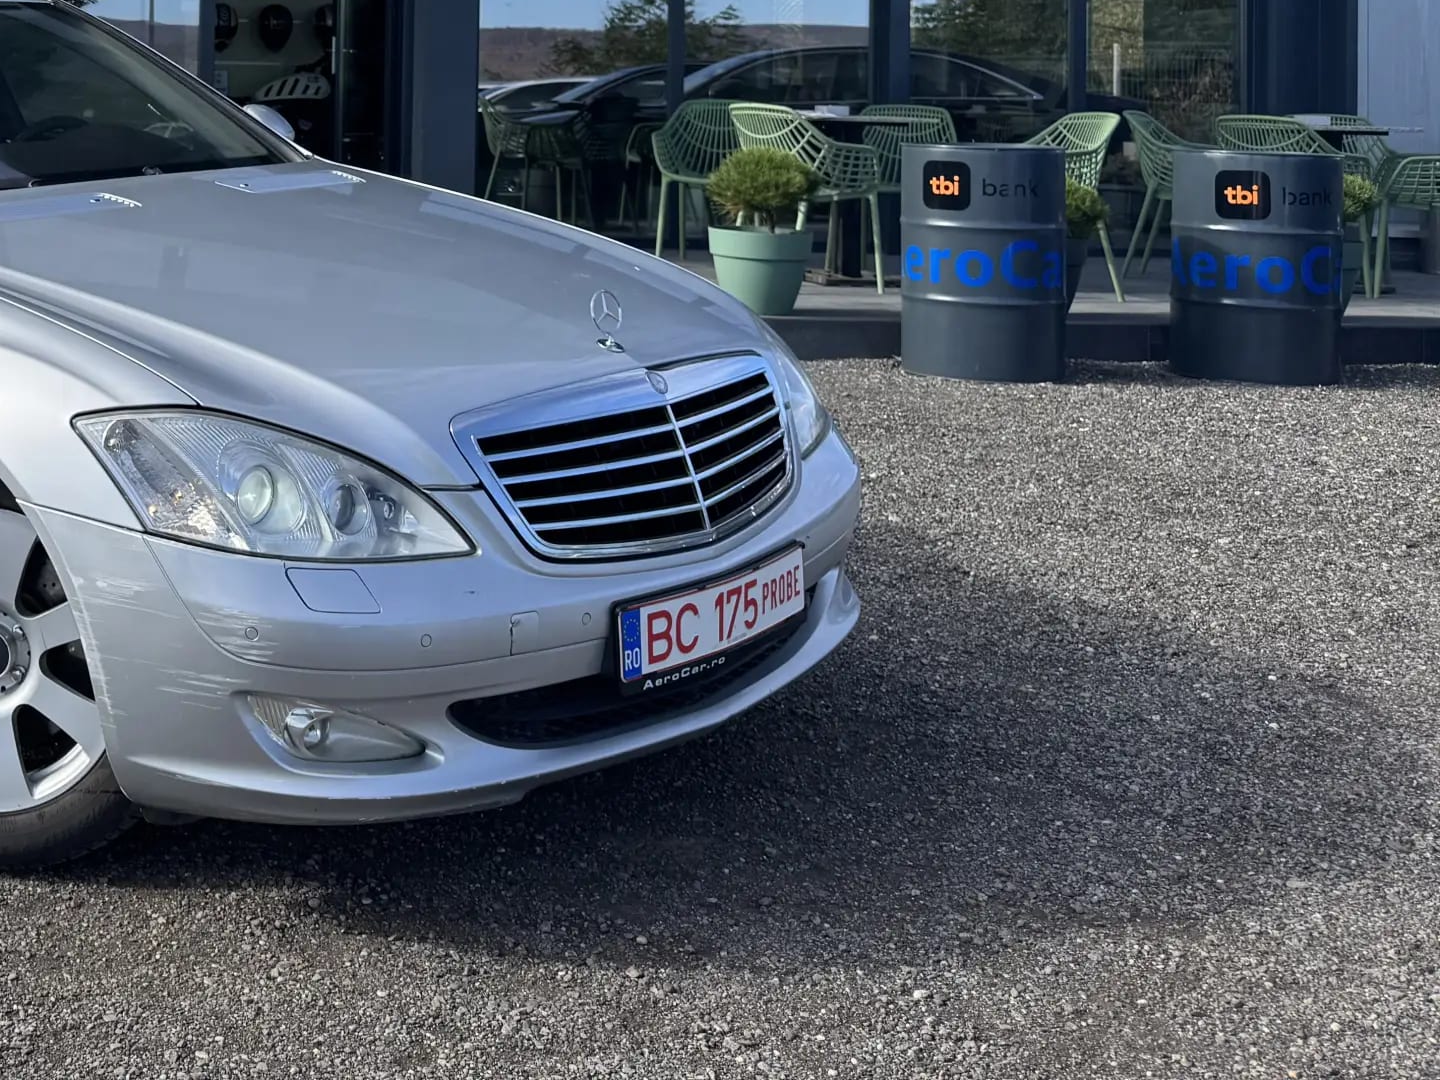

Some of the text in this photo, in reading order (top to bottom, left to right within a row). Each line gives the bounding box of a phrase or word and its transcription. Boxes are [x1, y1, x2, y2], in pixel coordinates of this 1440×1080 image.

[929, 175, 1040, 198] tbi bank
[1224, 184, 1333, 206] tbi bank
[647, 565, 801, 665] BC 175 PROBE
[625, 649, 640, 671] RO
[643, 657, 726, 690] AeroCar.ro
